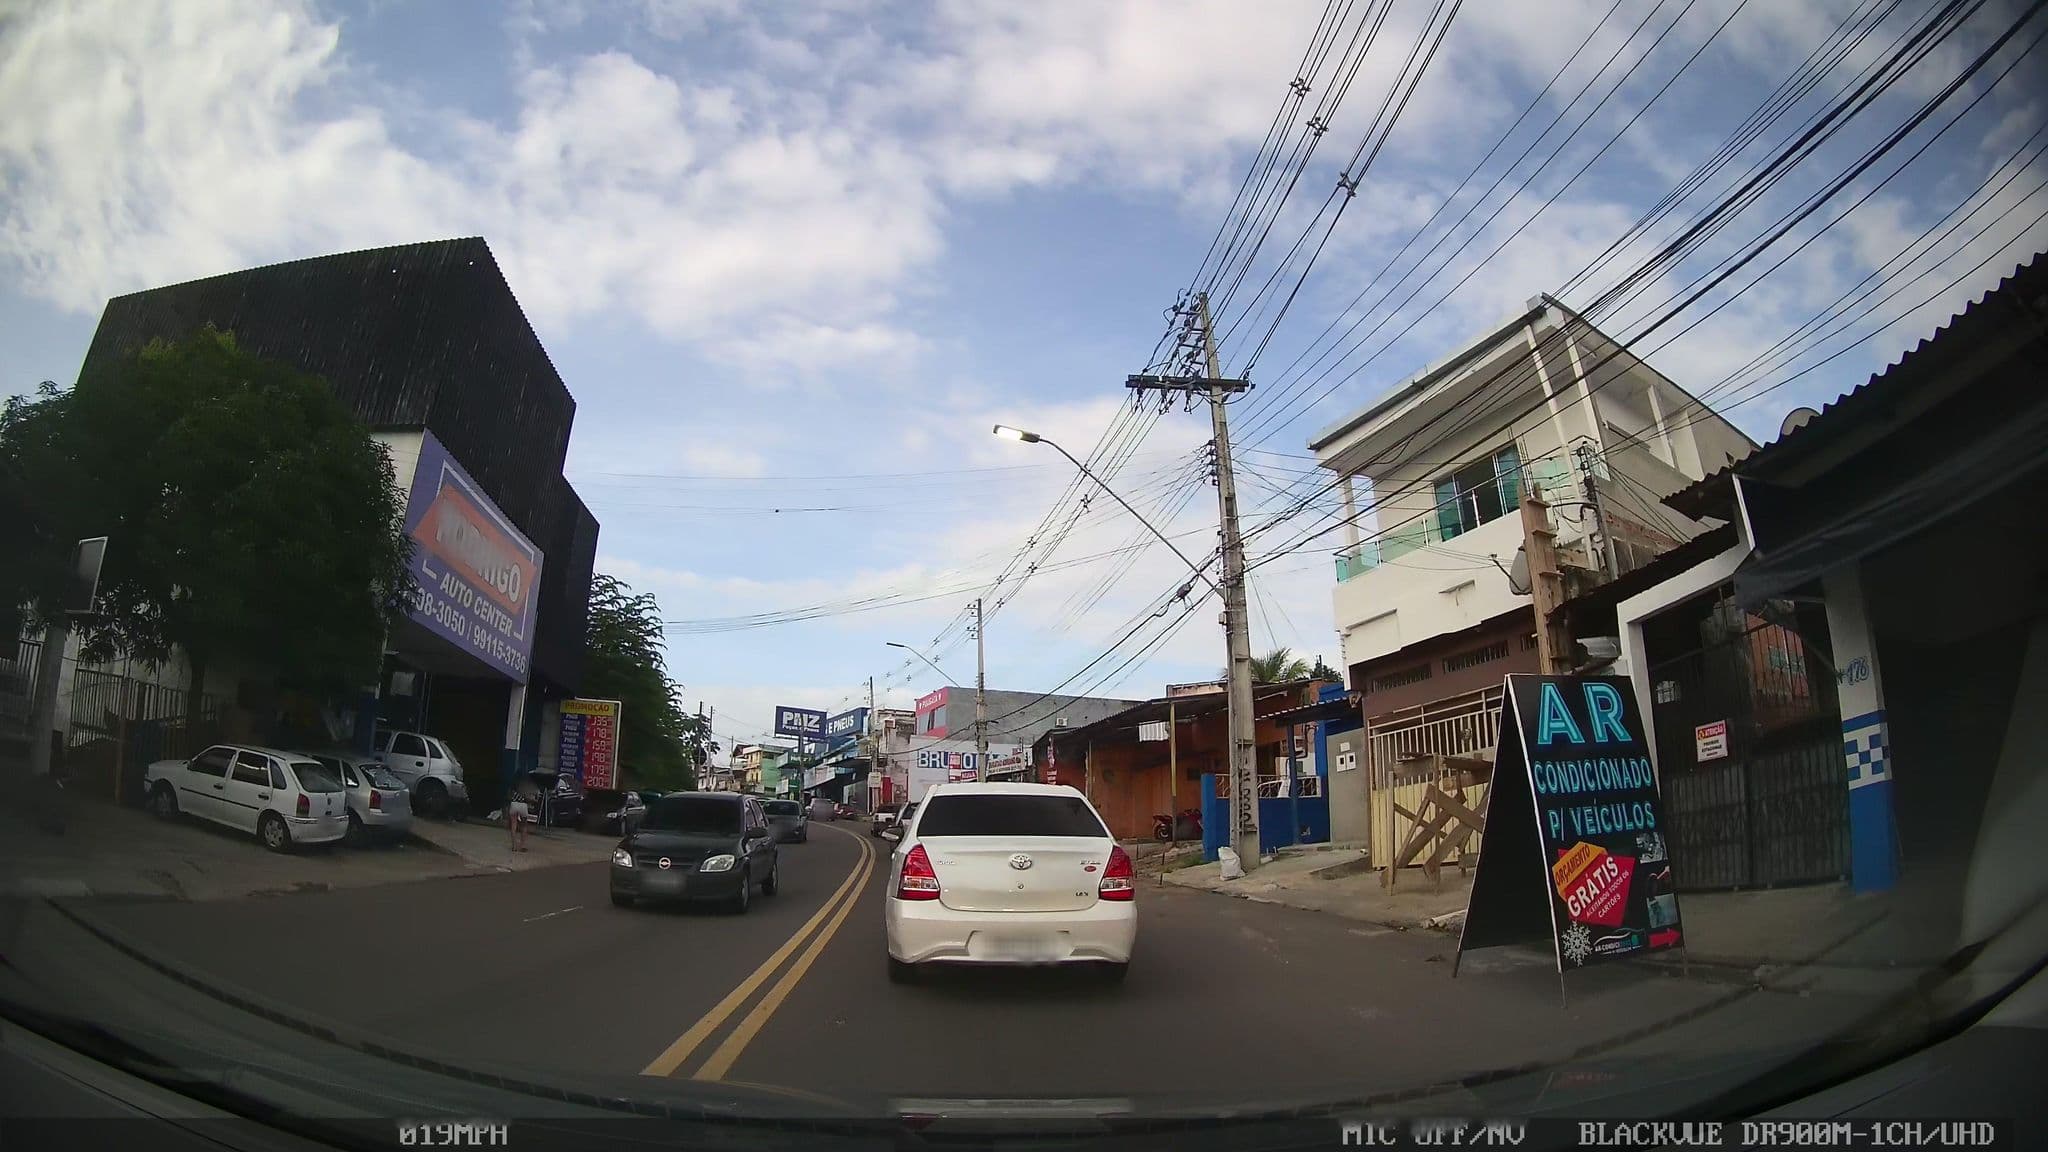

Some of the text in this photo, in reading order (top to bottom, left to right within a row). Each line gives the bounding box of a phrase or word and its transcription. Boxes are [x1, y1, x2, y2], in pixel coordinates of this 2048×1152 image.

[439, 575, 513, 637] AUTO CENTER
[473, 625, 526, 674] 99115-3736
[833, 715, 854, 733] PNEUS
[1537, 682, 1632, 745] AR
[1534, 756, 1651, 794] CONDICIONADO
[1548, 798, 1656, 841] P/ VEÍCULOS
[1555, 844, 1591, 886] ORÇAMENTO
[1567, 857, 1619, 917] GRÁTIS
[1598, 894, 1621, 918] CARTÕES
